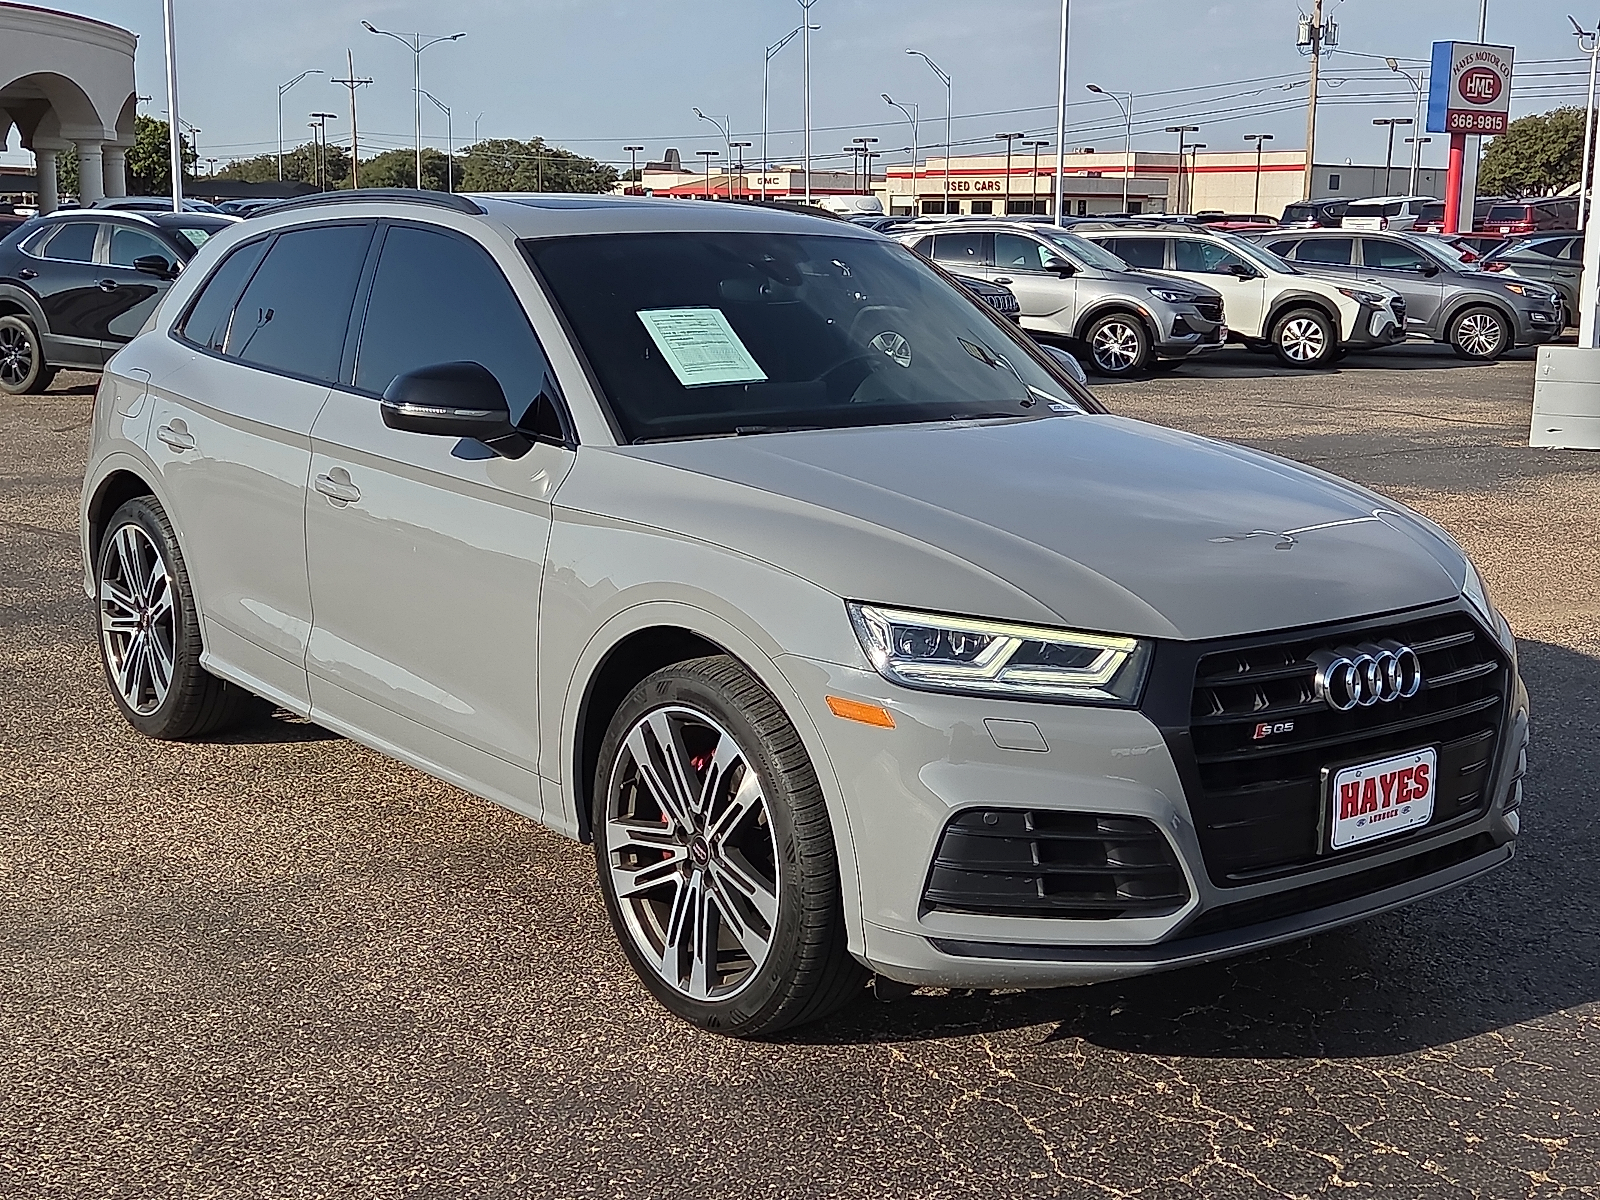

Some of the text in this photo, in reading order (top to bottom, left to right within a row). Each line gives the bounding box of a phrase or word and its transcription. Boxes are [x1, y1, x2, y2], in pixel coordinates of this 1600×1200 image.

[1453, 53, 1474, 76] HAYES
[1475, 51, 1501, 67] MOTOR
[1466, 73, 1494, 98] HMC
[1451, 113, 1503, 130] 368-9815
[757, 177, 780, 185] GMC
[974, 180, 1001, 191] CARS
[1260, 722, 1294, 736] SQ5
[1340, 763, 1429, 821] HAYES
